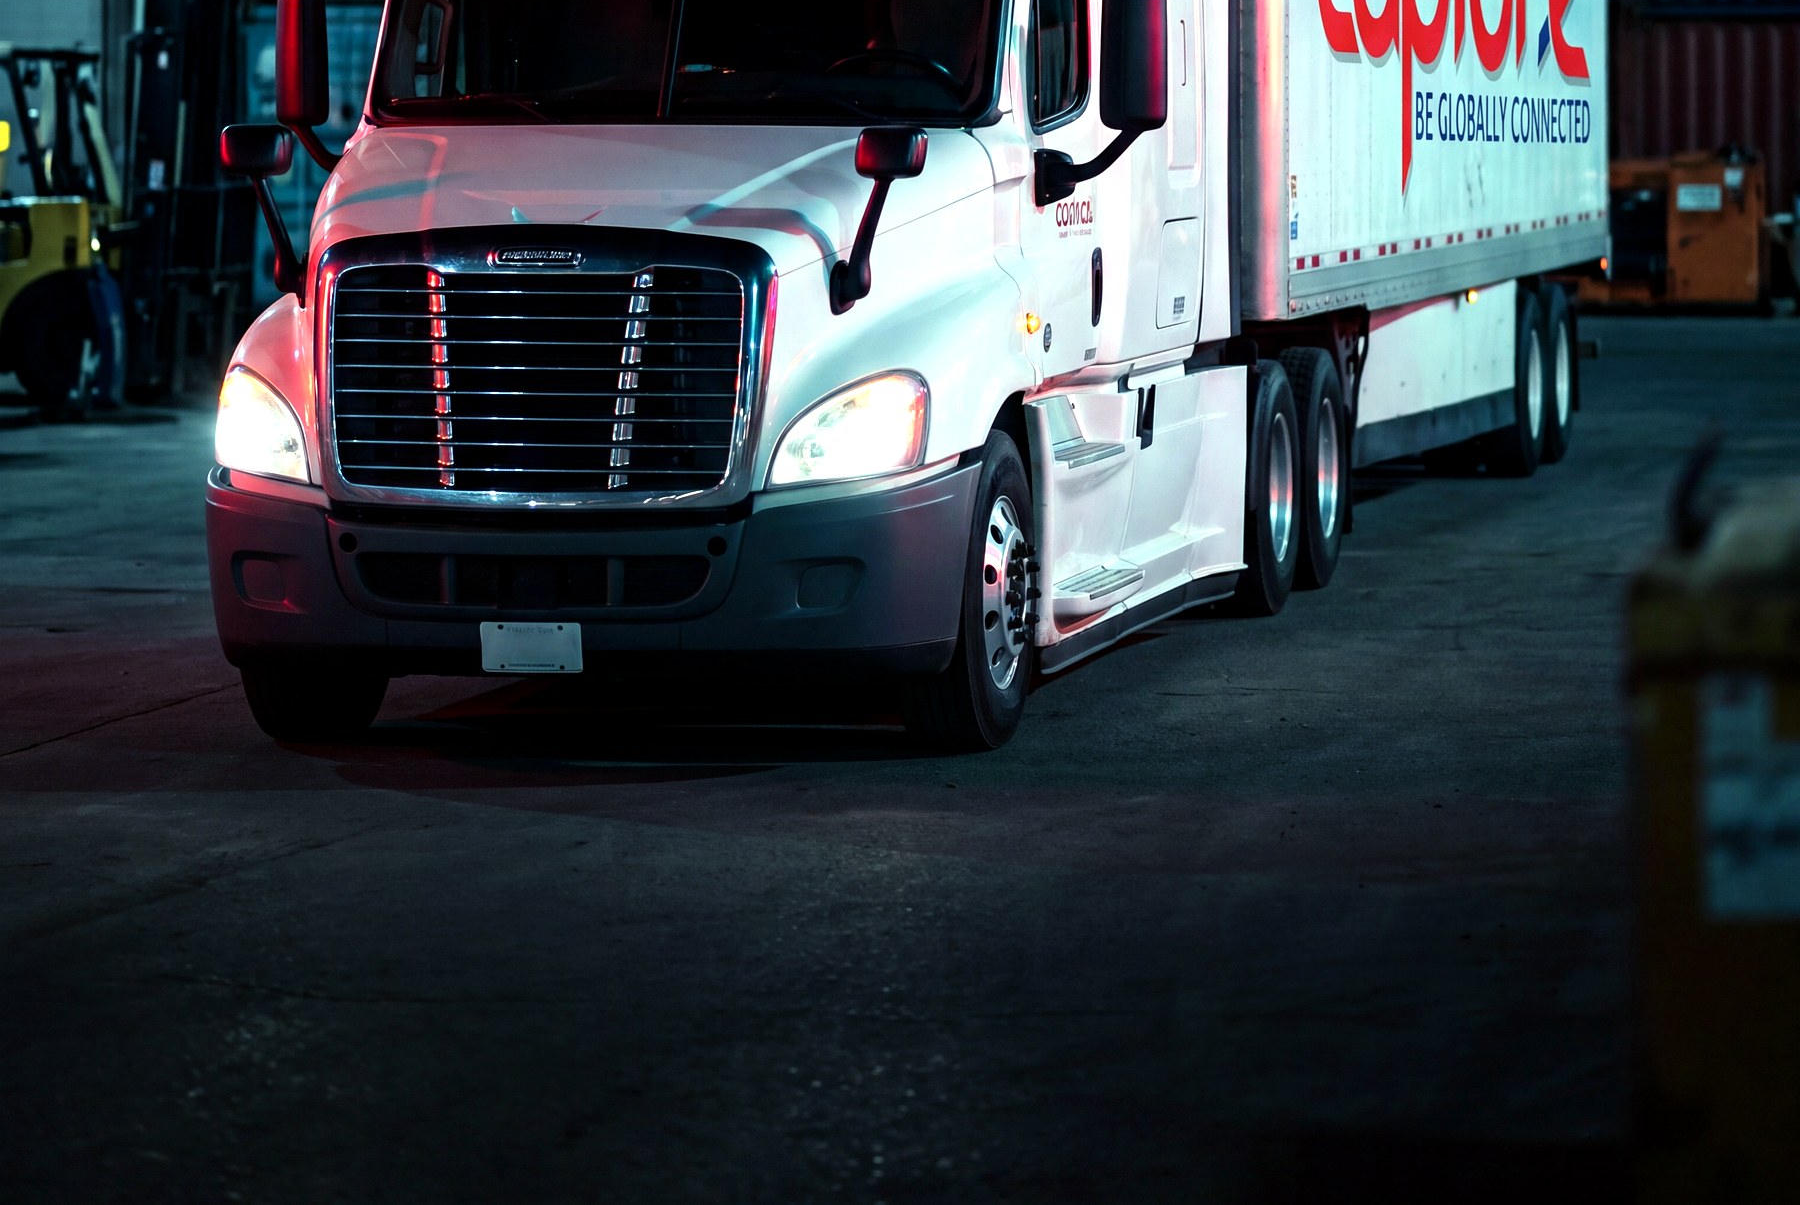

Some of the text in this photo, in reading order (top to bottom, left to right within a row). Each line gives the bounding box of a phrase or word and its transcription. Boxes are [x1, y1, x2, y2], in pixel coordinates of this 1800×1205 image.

[1415, 91, 1591, 144] BE GLOBALLY CONNECTED
